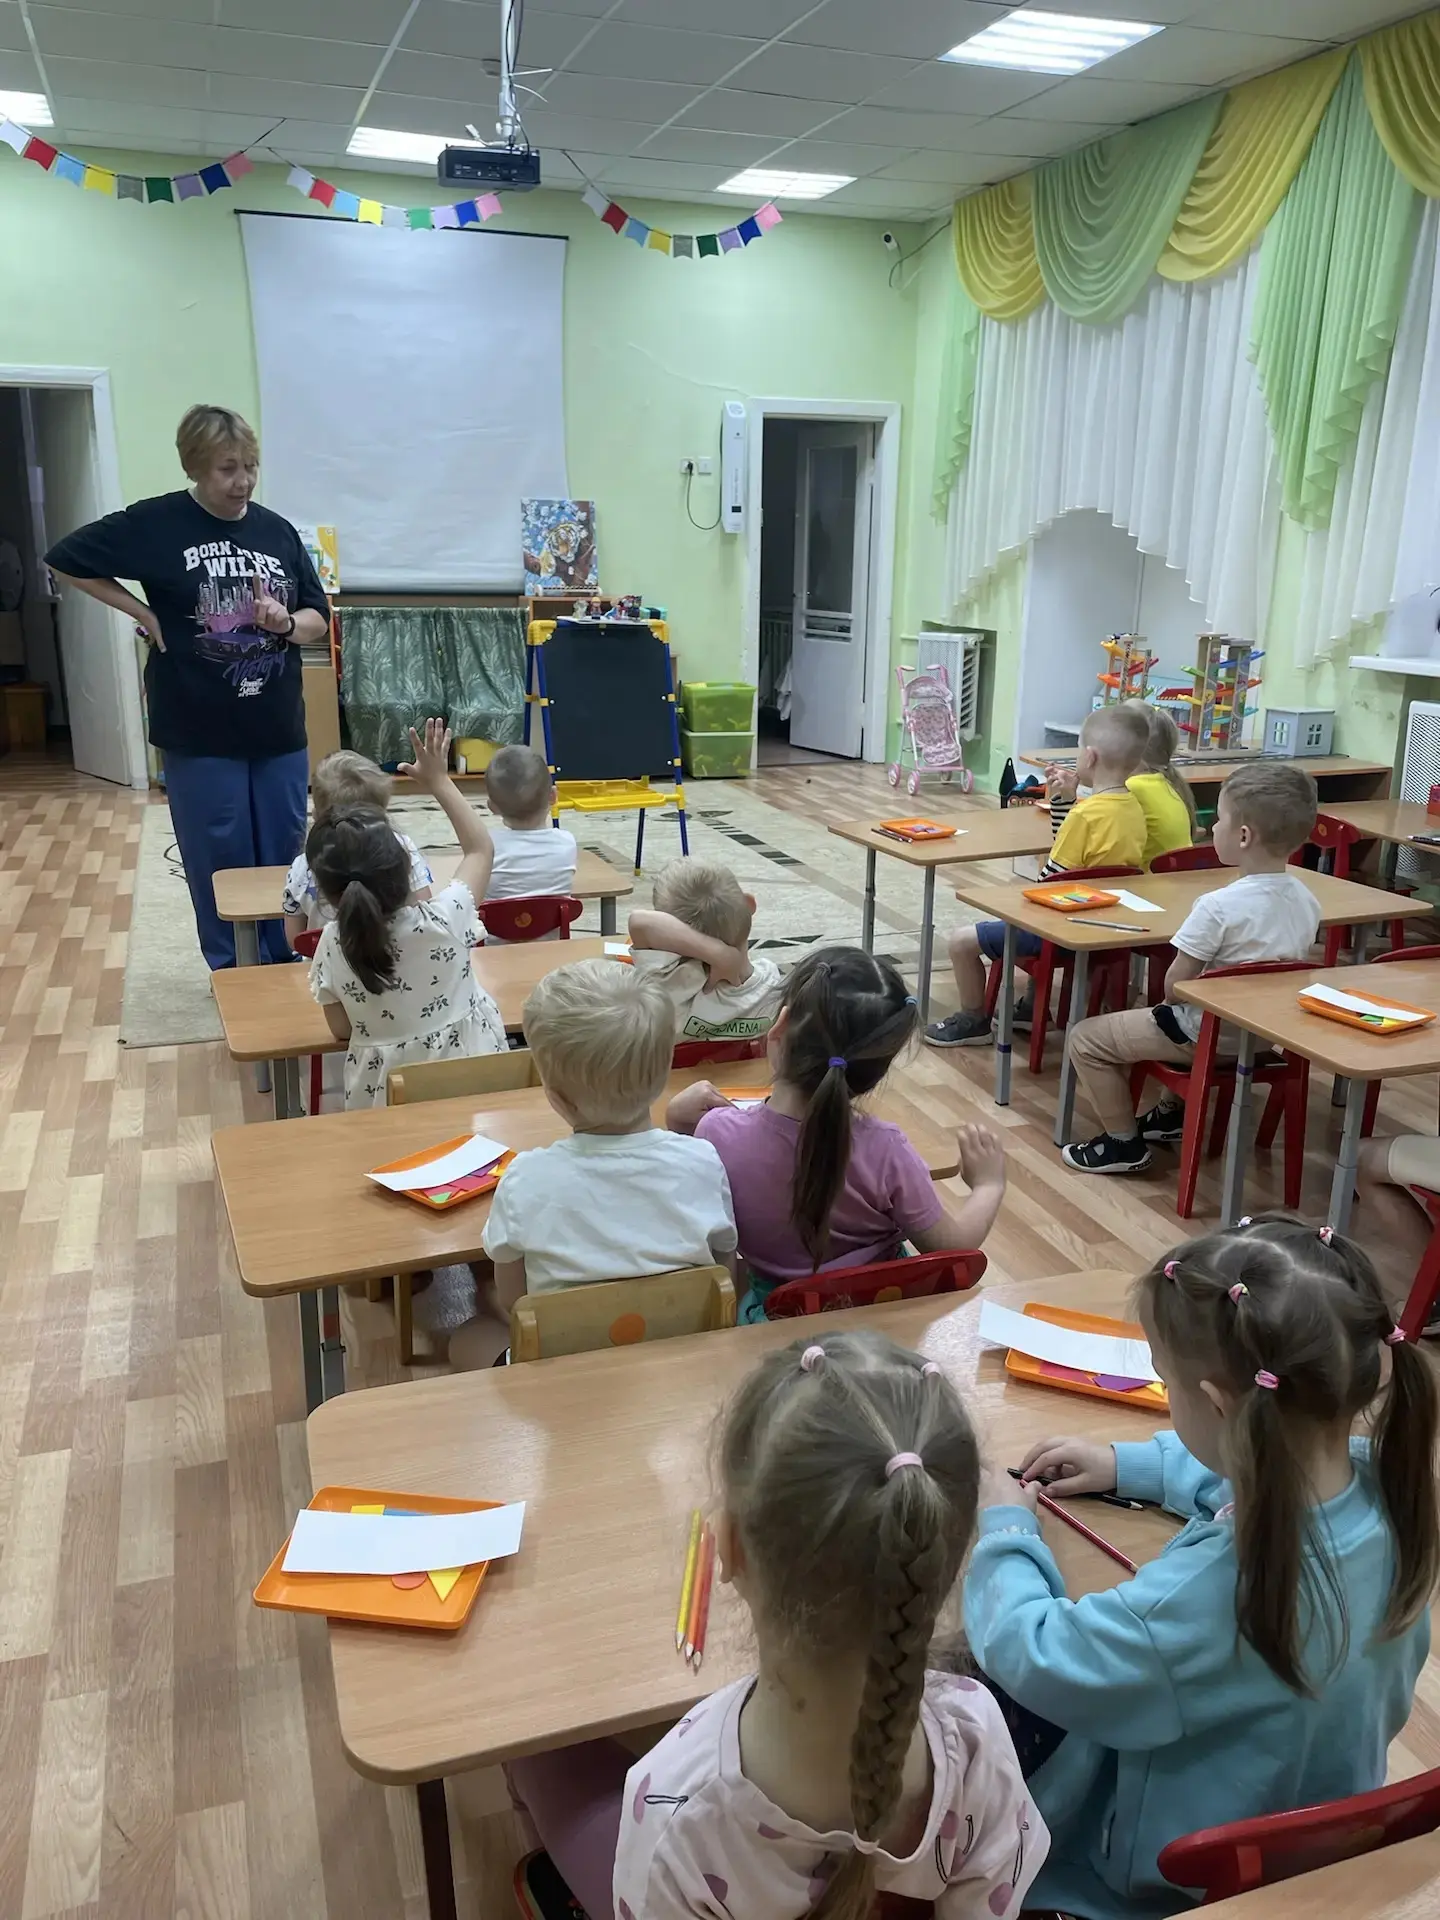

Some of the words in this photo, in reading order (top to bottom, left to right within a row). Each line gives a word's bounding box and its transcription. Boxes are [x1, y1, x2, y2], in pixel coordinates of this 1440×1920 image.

[183, 541, 232, 571] BORN
[252, 551, 285, 577] BE
[203, 556, 271, 579] WILD
